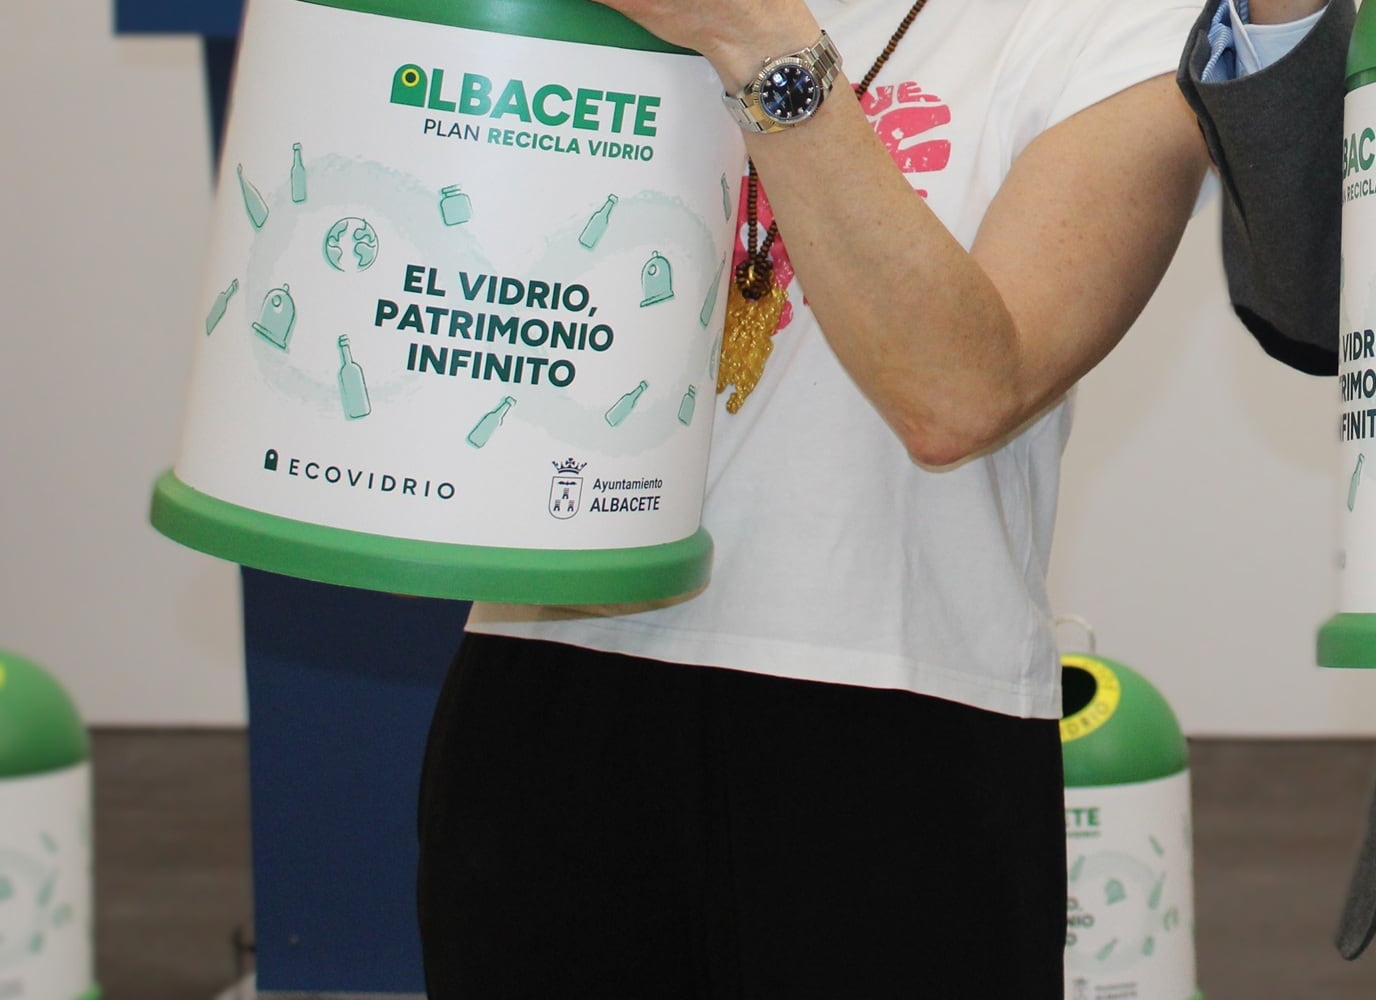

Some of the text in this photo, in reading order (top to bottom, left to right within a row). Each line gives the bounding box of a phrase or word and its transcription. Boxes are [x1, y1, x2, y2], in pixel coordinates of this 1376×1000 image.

[423, 118, 655, 162] PLAN RECICLA VIDRIO
[403, 264, 599, 318] EL VIDRIO,
[374, 298, 615, 352] PATRIMONIO
[406, 343, 576, 388] INFINITO
[288, 458, 456, 501] ECOVIDRIO
[593, 476, 664, 493] Ayuntamiento
[590, 496, 662, 513] ALBACETE
